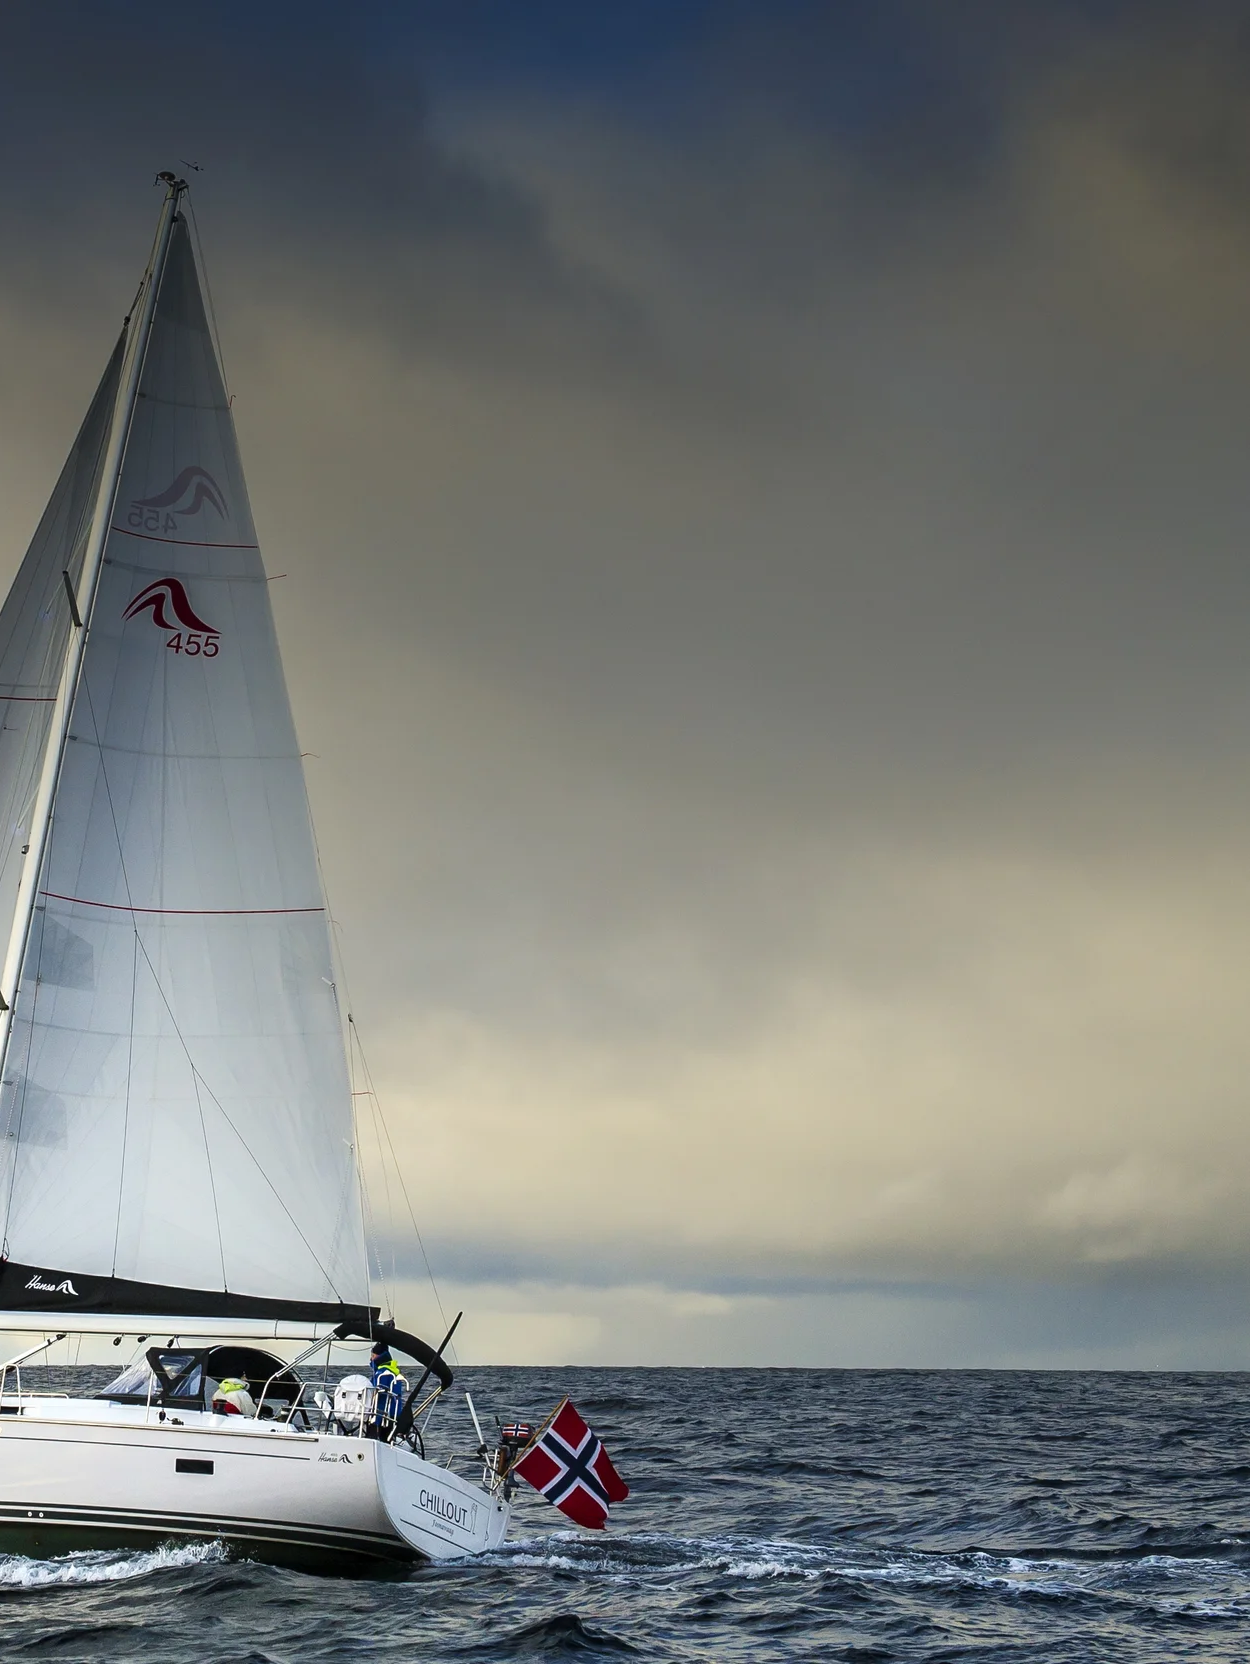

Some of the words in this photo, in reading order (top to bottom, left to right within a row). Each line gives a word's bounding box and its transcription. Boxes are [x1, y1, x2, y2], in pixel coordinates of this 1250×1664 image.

[166, 632, 220, 657] 455
[25, 1275, 55, 1291] Hanse
[420, 1489, 468, 1526] CHILLOUT
